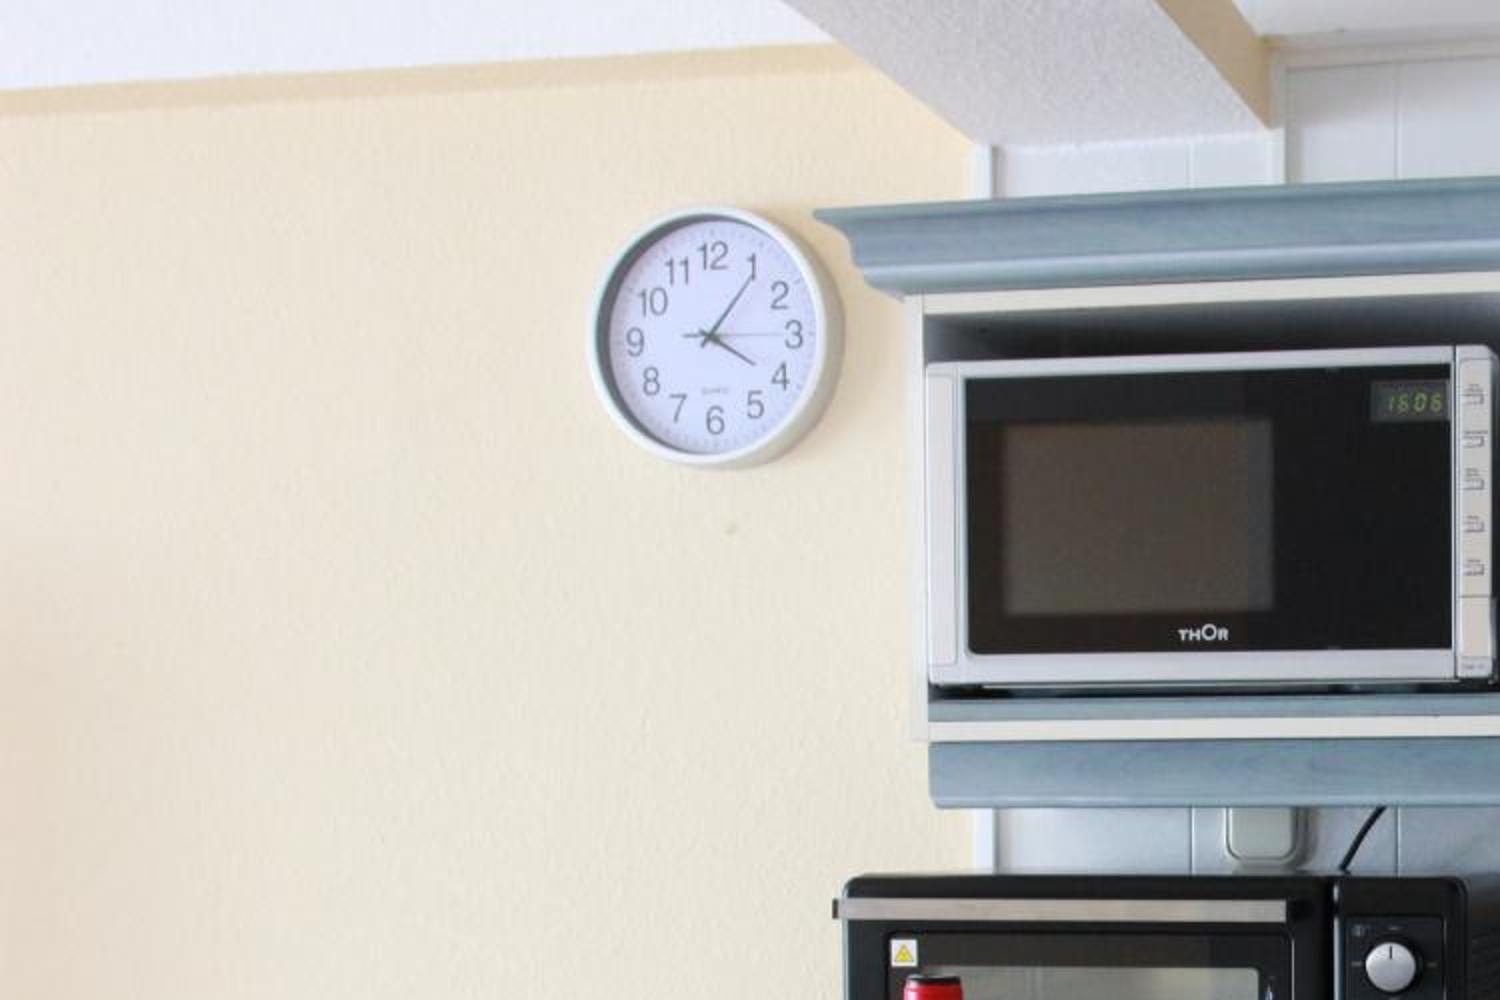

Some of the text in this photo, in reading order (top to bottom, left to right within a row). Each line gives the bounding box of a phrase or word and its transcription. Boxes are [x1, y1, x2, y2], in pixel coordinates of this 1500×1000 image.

[697, 240, 729, 271] 12
[747, 253, 757, 280] 1
[665, 256, 690, 286] 11
[638, 286, 669, 317] 10
[770, 280, 790, 310] 2
[626, 327, 645, 357] 9
[784, 319, 805, 350] 3
[642, 366, 661, 397] 8
[771, 361, 791, 391] 4
[669, 393, 688, 423] 7
[746, 389, 766, 419] 5
[705, 405, 726, 435] 6
[1178, 623, 1230, 641] THOR
